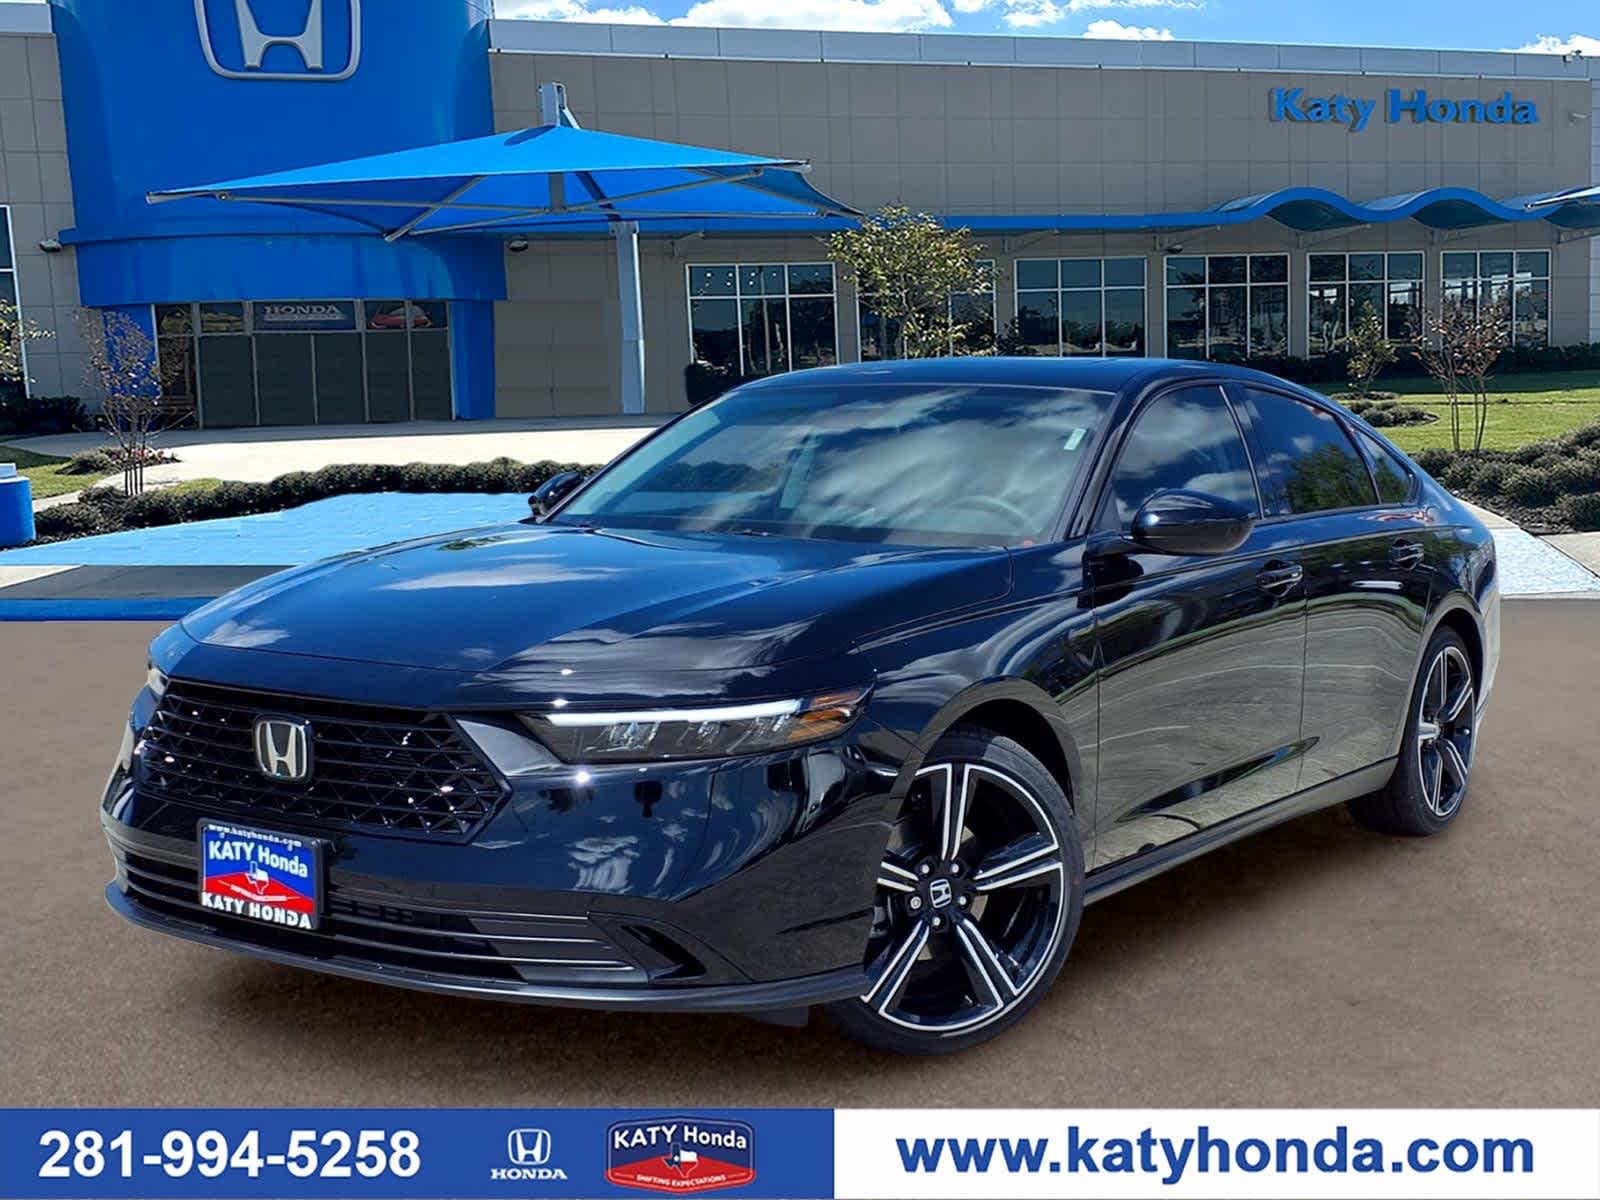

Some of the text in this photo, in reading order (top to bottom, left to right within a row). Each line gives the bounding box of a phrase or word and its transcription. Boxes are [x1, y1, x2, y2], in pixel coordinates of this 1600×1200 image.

[1270, 86, 1539, 132] Katy Honda
[264, 304, 342, 315] HONDA
[208, 840, 308, 878] KATY Honda
[201, 891, 244, 914] KATY
[248, 902, 312, 929] HONDA
